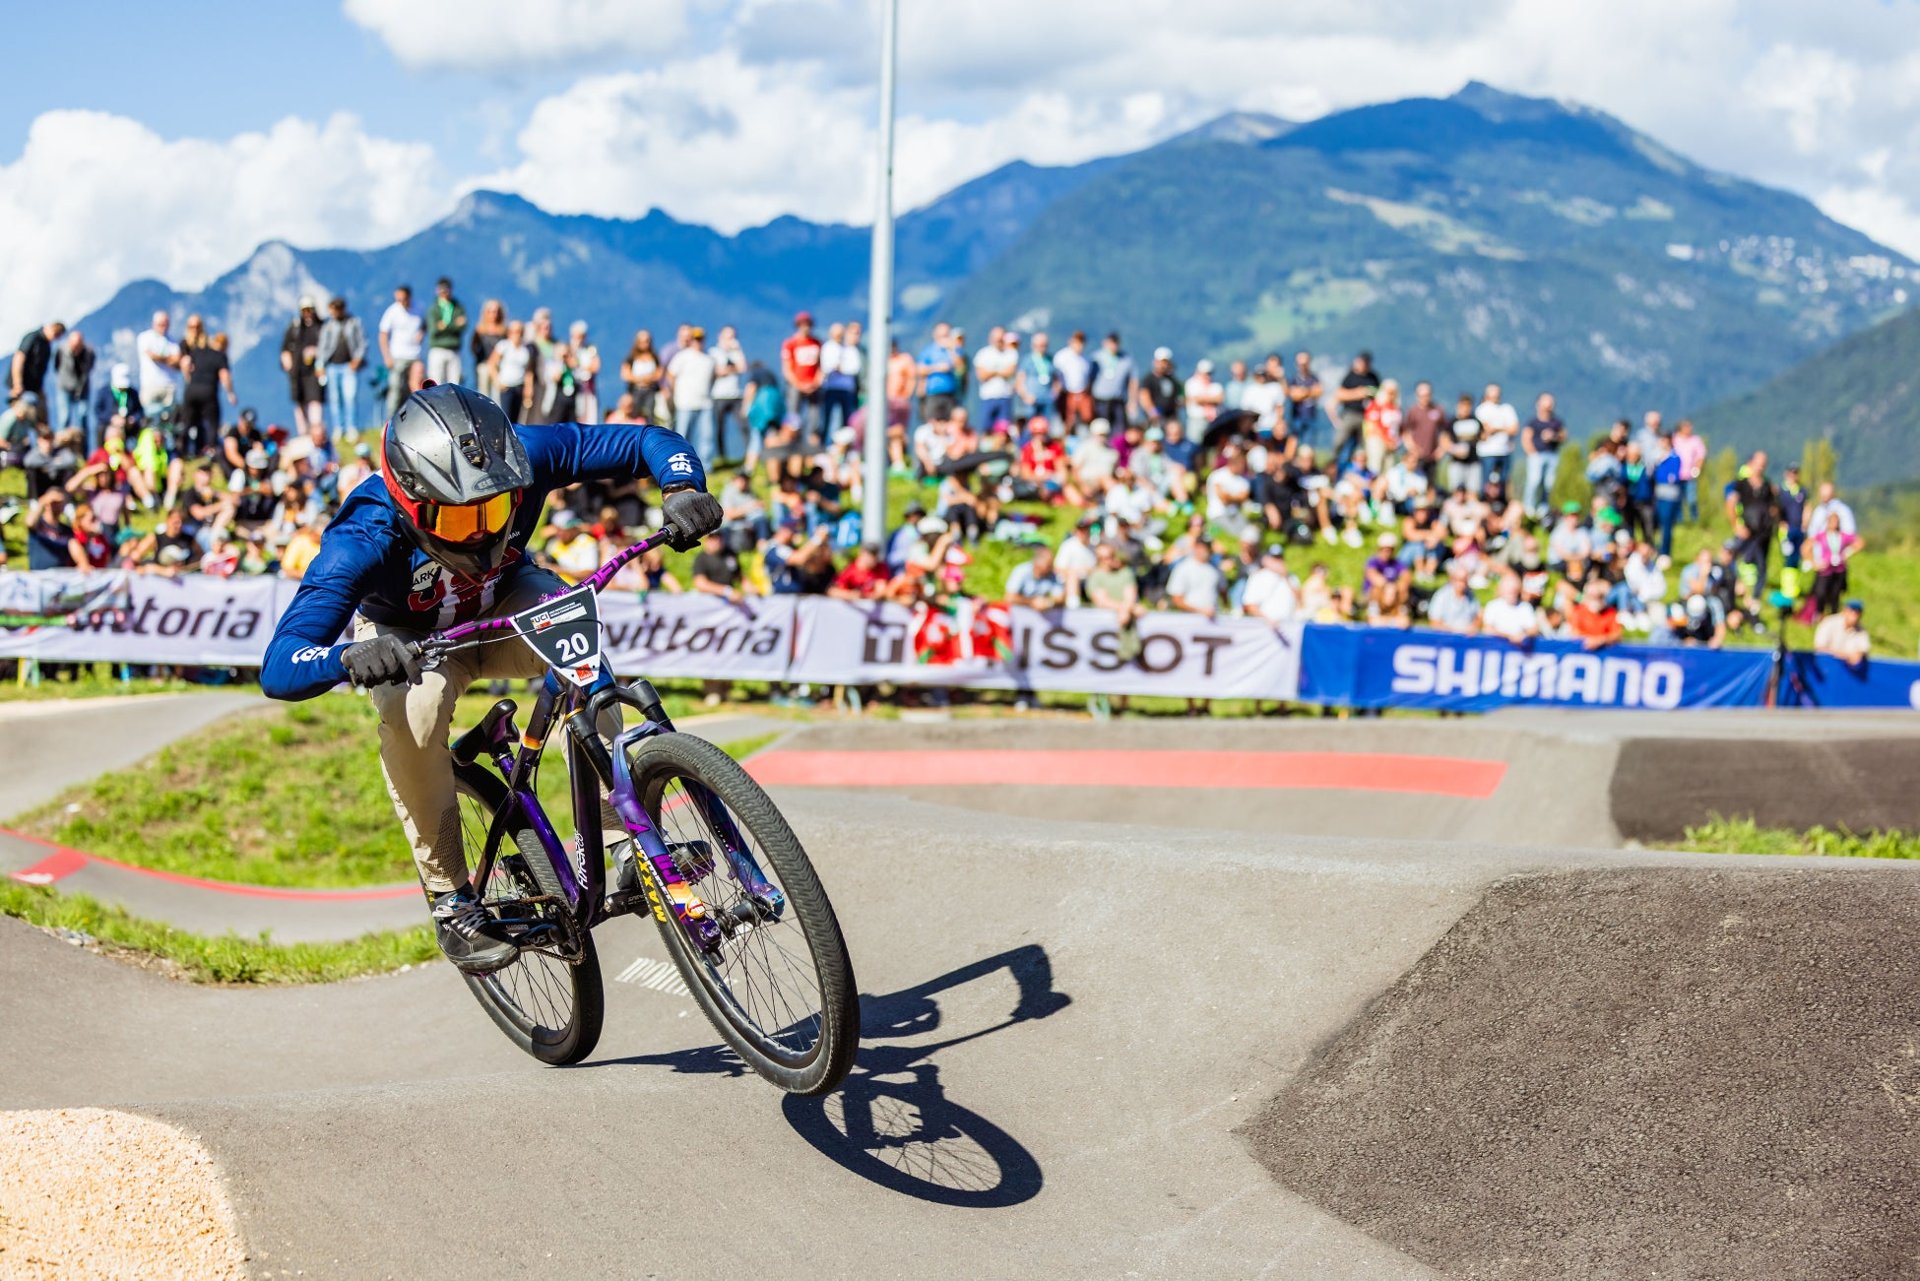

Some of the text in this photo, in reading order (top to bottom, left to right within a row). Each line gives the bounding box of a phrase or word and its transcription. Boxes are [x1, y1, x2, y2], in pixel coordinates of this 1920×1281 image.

[74, 597, 261, 640] toria
[534, 612, 550, 624] UCI
[604, 611, 781, 656] vittoria
[555, 632, 590, 663] 20
[974, 627, 1232, 676] ISSOT
[1391, 645, 1684, 710] SHIMANO
